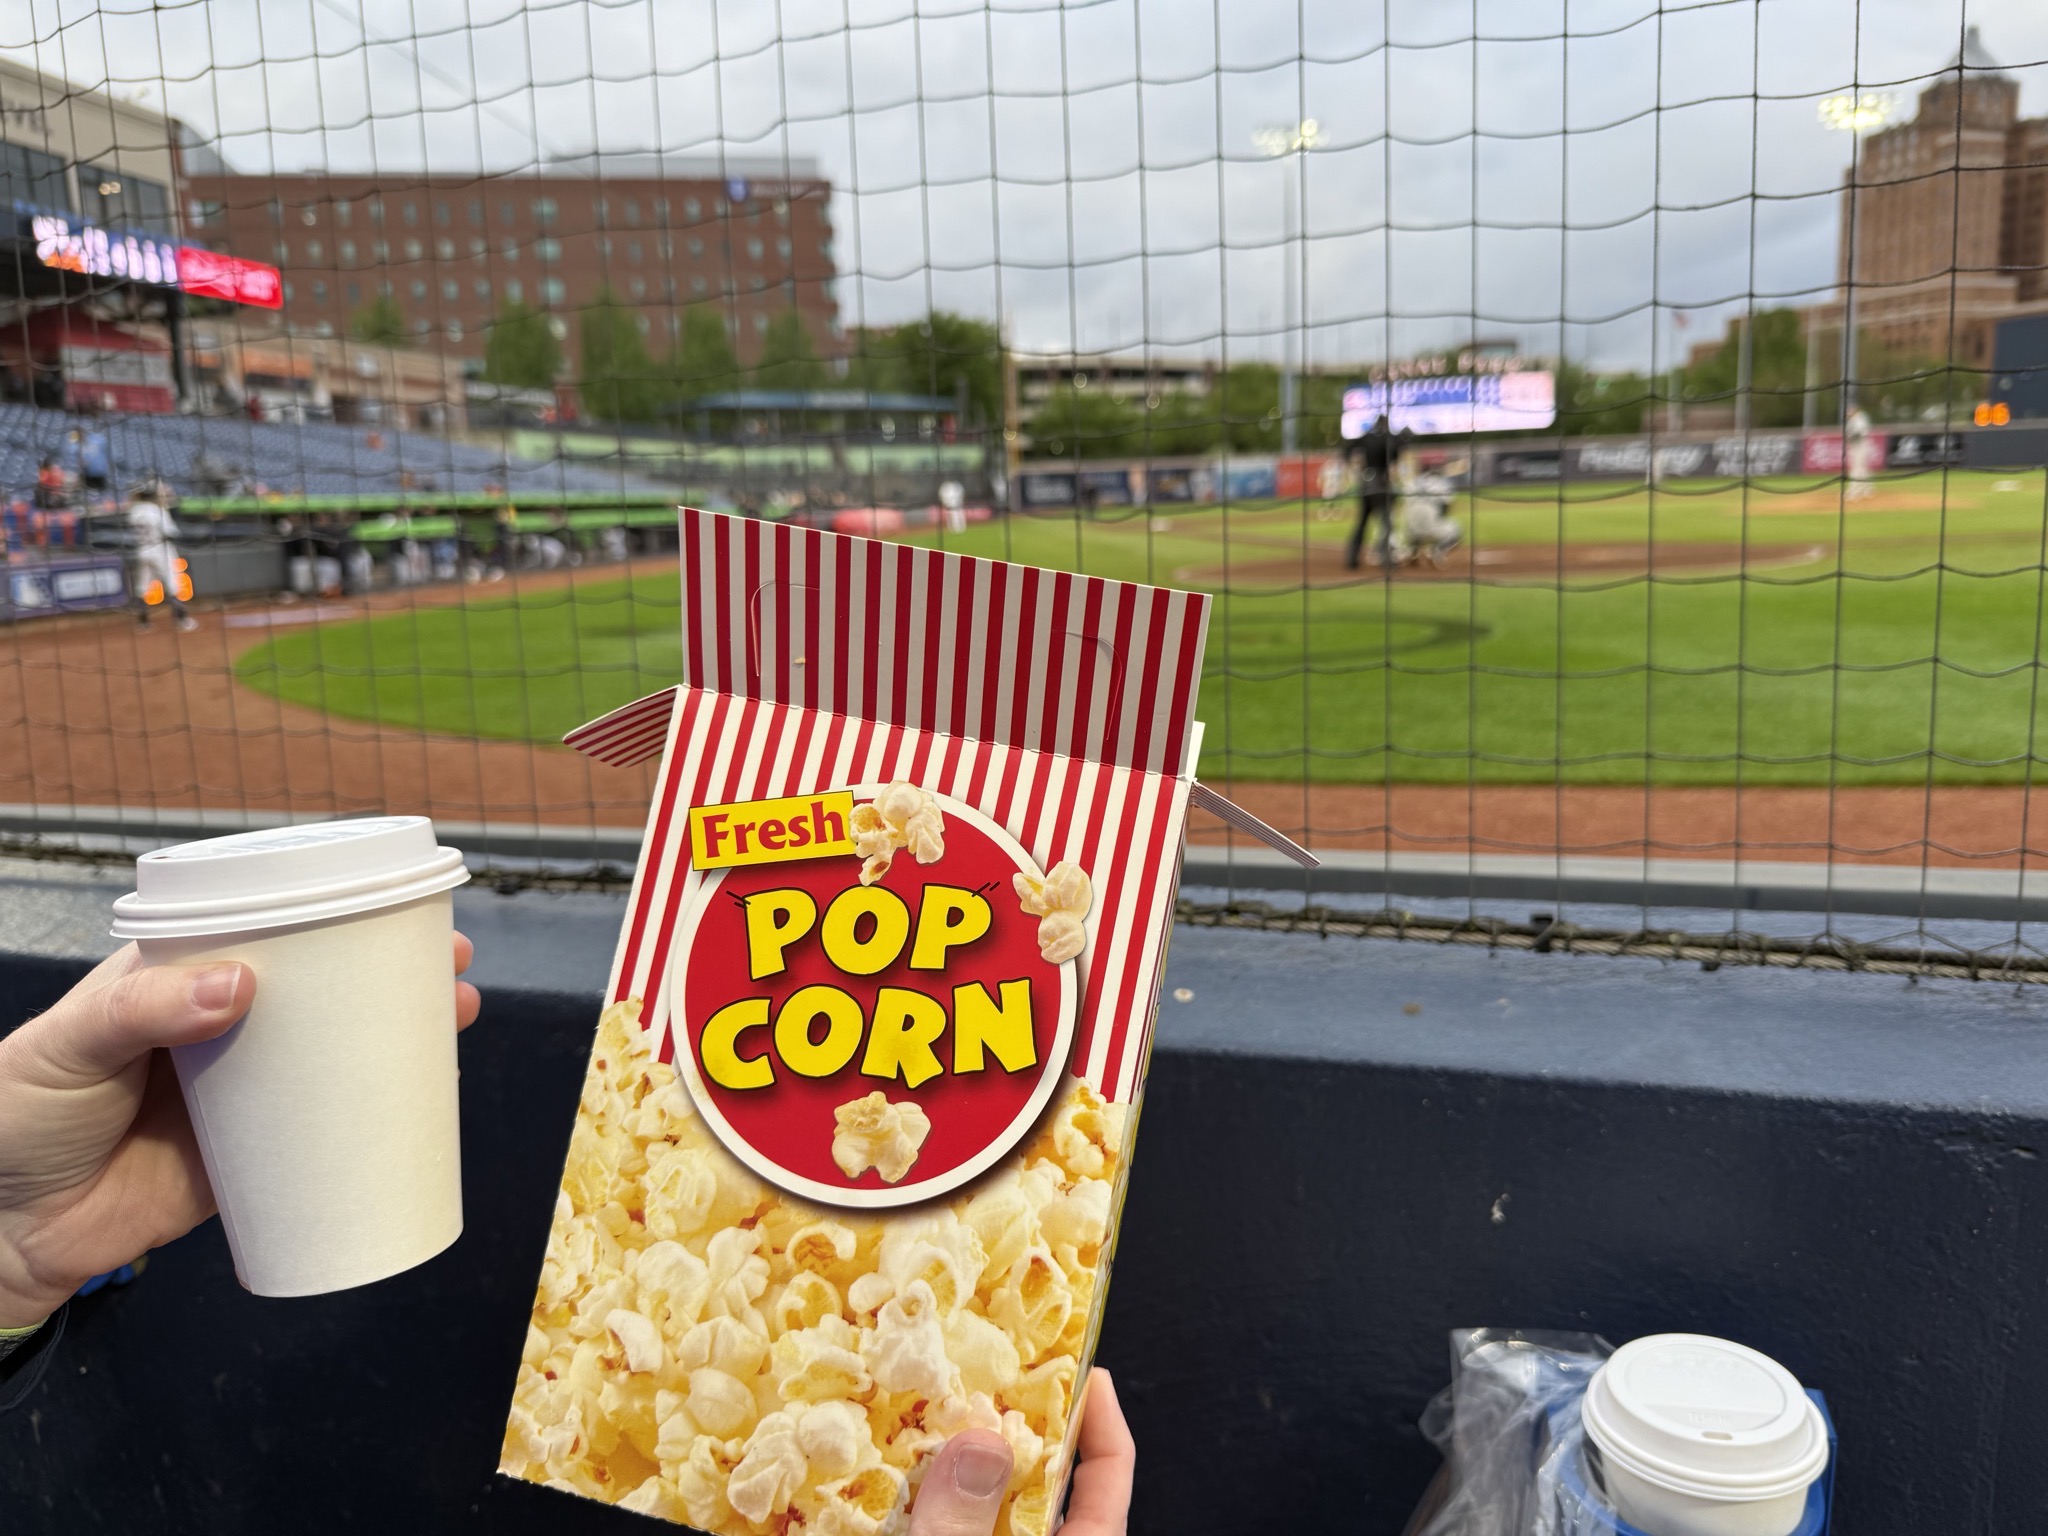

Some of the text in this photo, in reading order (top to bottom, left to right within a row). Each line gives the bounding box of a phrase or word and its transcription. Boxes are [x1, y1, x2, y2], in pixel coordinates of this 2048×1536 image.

[703, 801, 846, 858] Fresh
[745, 884, 992, 980] POP
[700, 978, 1037, 1090] CORN
